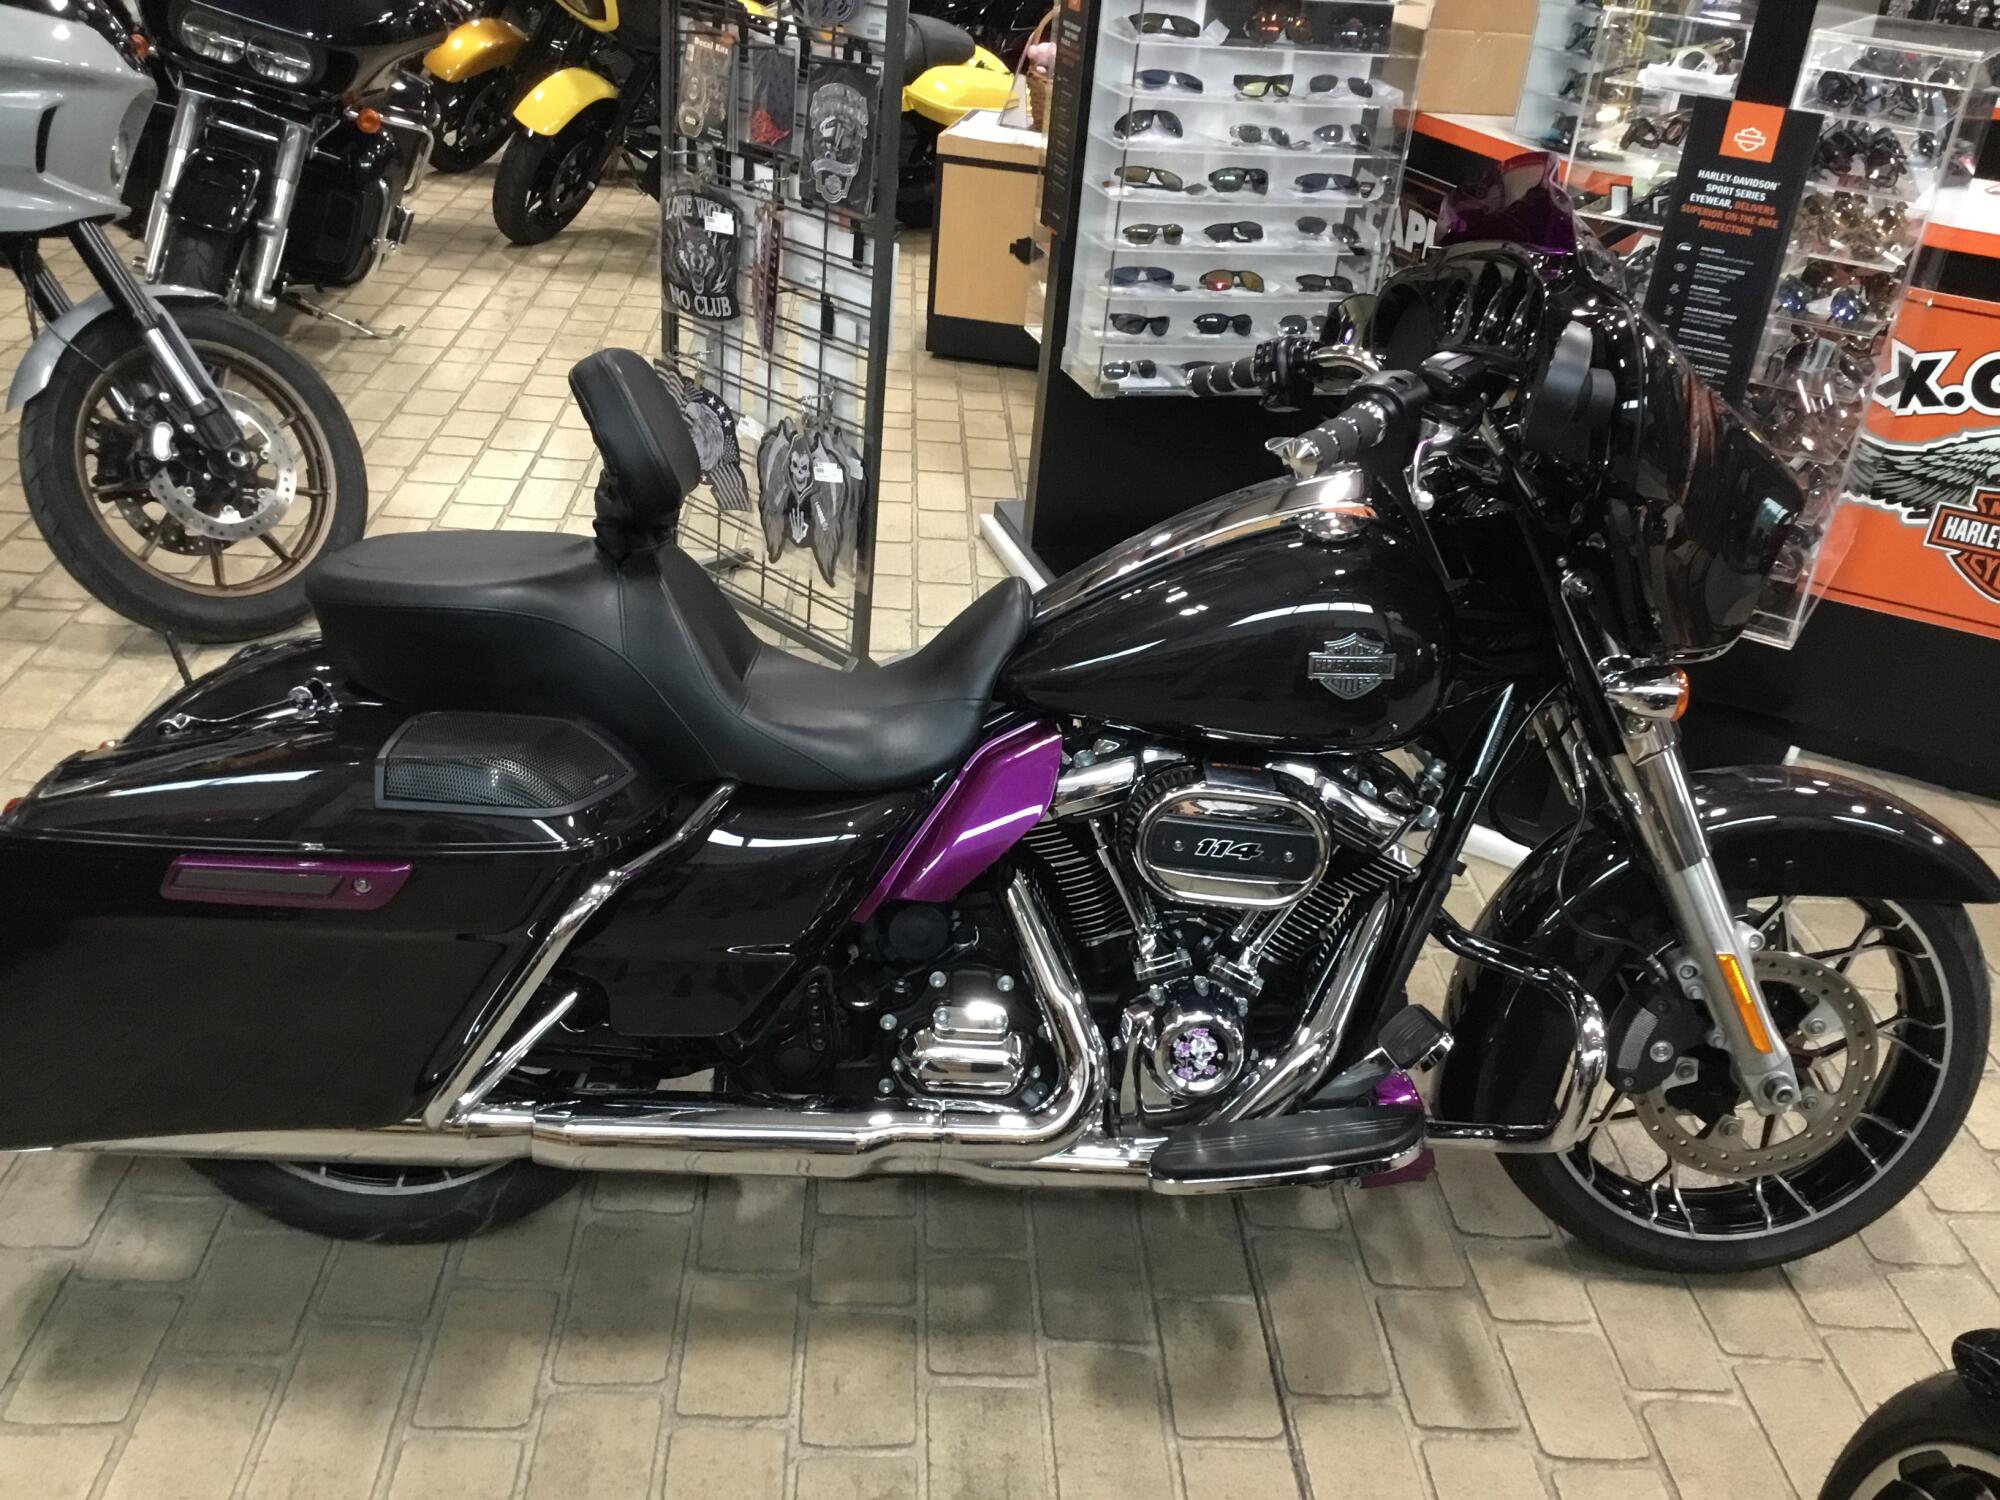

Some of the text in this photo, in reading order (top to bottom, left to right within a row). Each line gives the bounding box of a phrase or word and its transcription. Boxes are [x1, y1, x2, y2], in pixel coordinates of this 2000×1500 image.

[1698, 169, 1778, 191] HARLEY-DAVIDSON
[1689, 192, 1777, 216] EYEWEAR, DELIVERS
[1705, 183, 1767, 202] SPORT SERIES
[665, 195, 693, 220] LONE
[1680, 203, 1724, 219] SUPERIOR
[668, 281, 732, 317] NO CLUB
[1942, 515, 2000, 550] HARLE
[1194, 837, 1265, 861] 114
